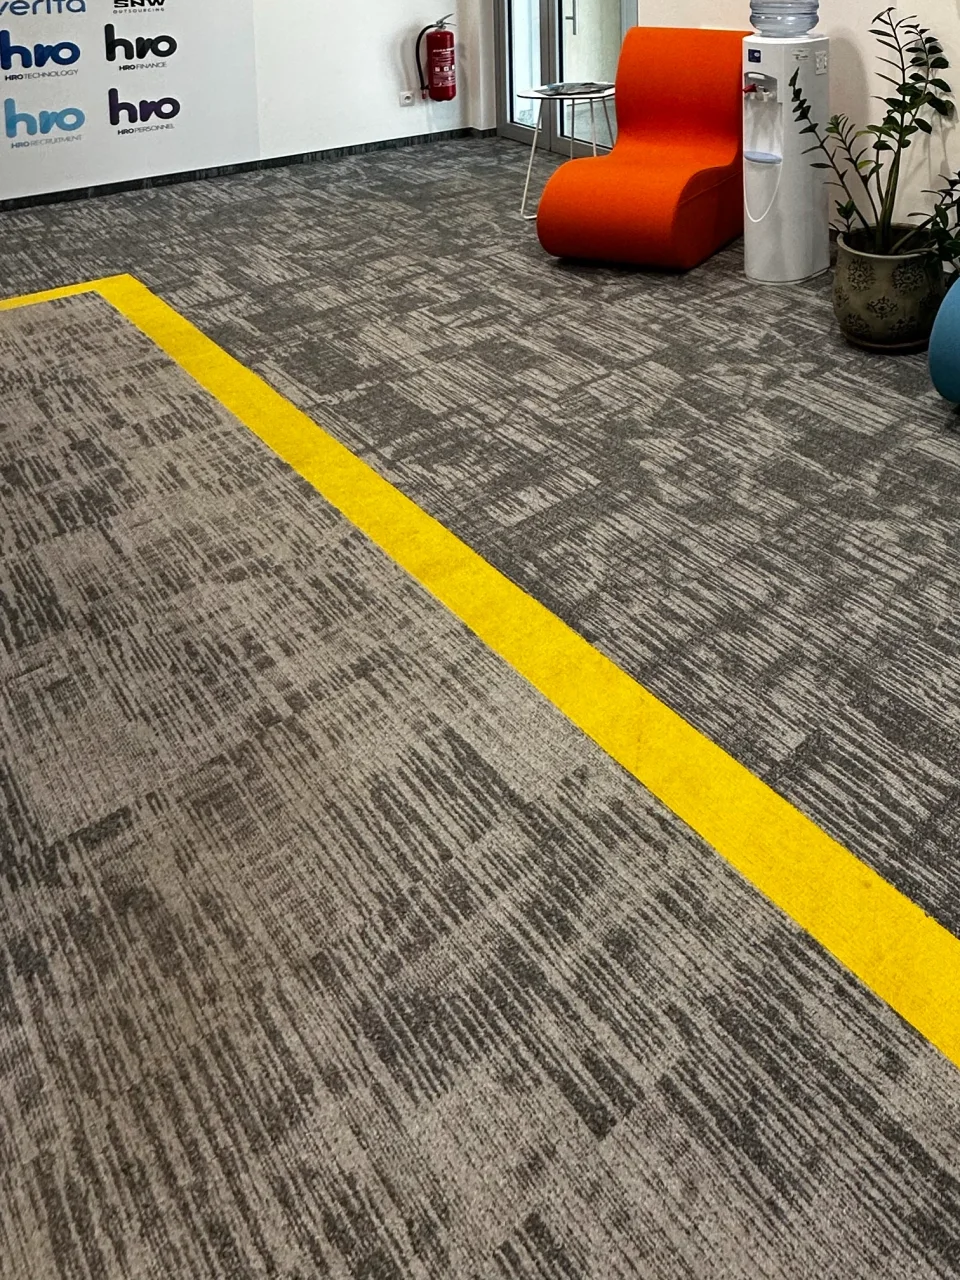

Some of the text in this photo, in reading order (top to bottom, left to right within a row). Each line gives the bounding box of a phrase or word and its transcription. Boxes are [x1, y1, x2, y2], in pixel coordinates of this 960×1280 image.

[0, 29, 80, 70] hro
[104, 23, 178, 62] hro
[4, 97, 86, 138] hro
[108, 87, 181, 126] hro
